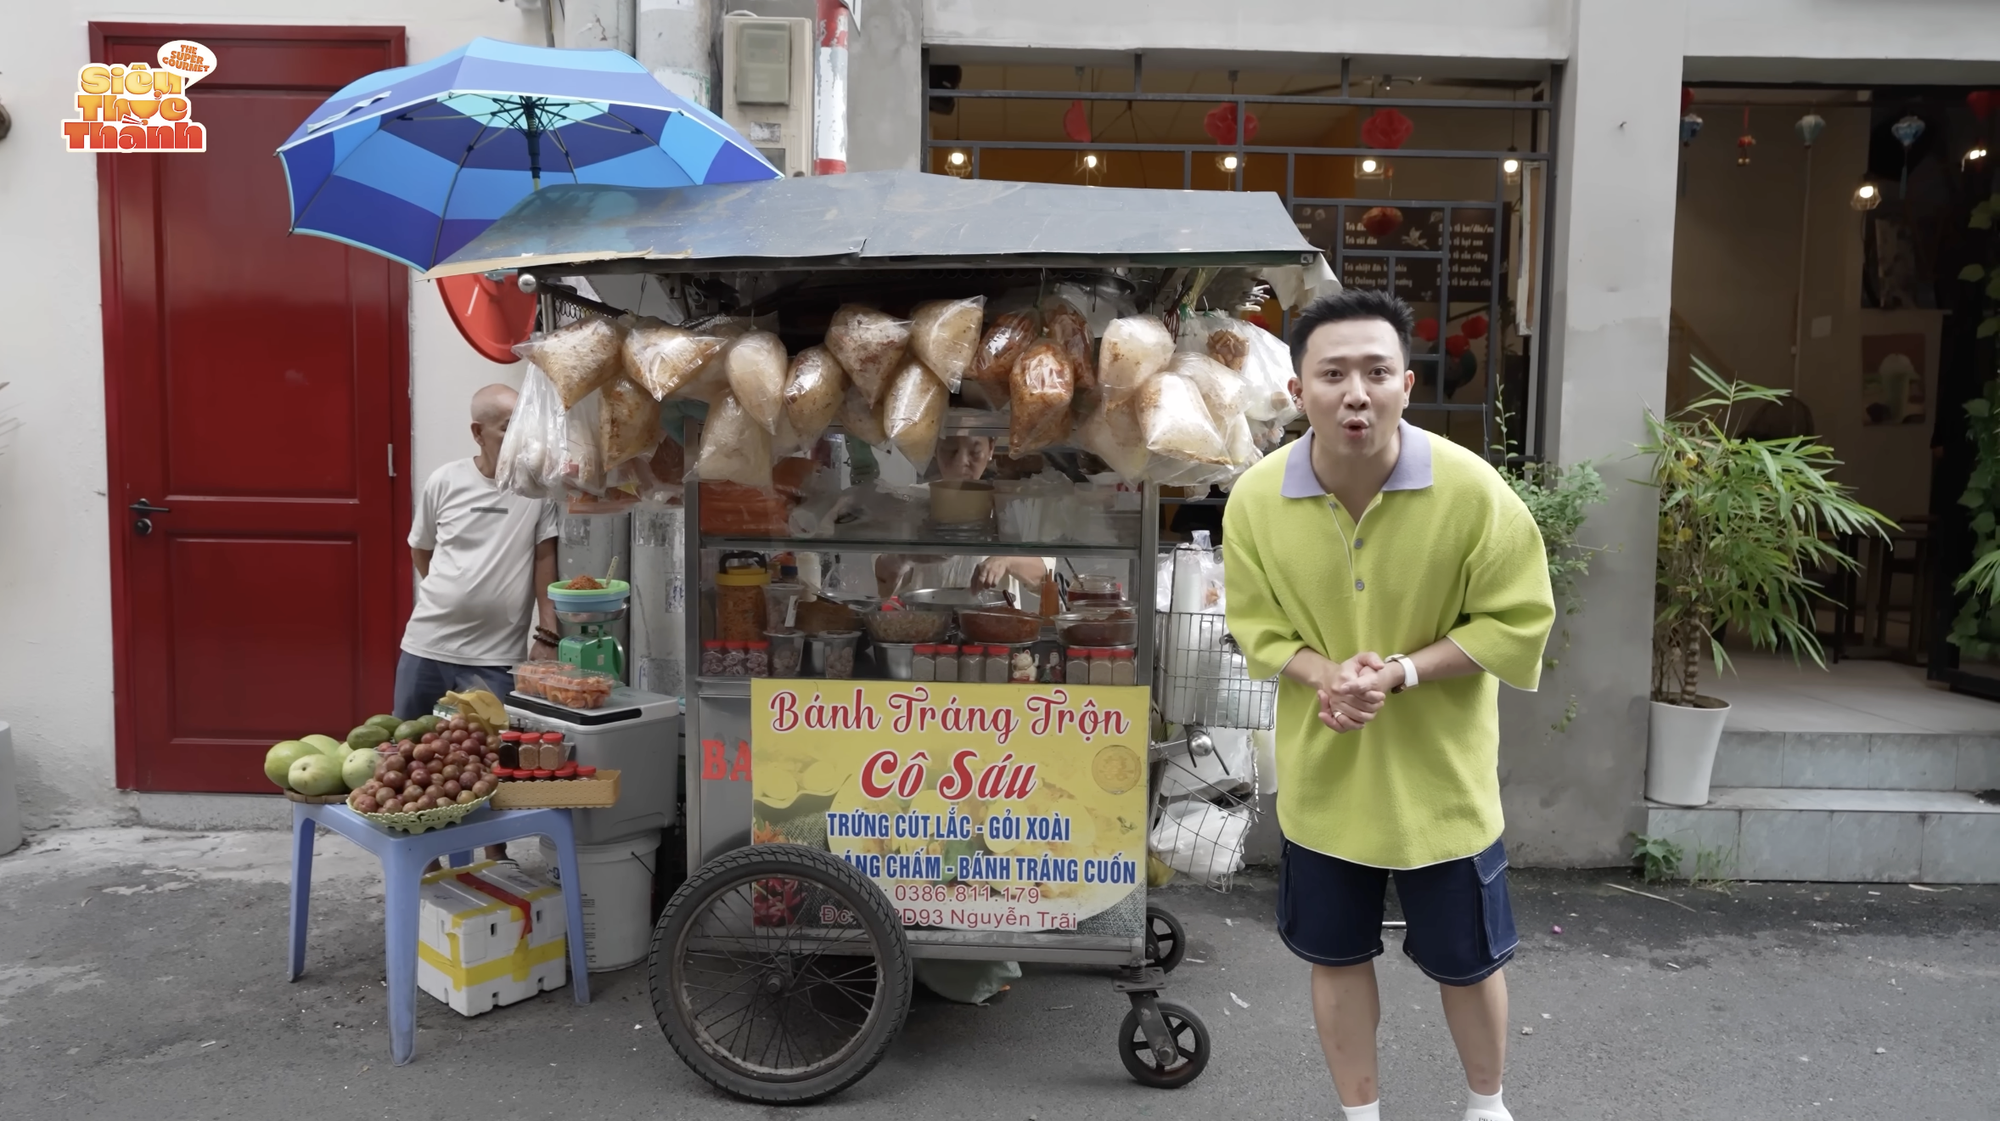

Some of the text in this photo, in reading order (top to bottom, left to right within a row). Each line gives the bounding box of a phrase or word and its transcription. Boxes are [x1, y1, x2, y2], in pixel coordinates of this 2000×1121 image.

[769, 686, 1130, 744] Bánh Tráng Trộn
[860, 750, 1037, 801] Cô Sáu
[827, 809, 890, 838] TRỨNG
[895, 810, 931, 839] CÚT
[935, 806, 972, 840] LẮC
[989, 808, 1021, 840] GỎI
[1025, 812, 1071, 841] XOÀI
[886, 847, 941, 879] CHẤM
[959, 852, 1011, 880] BÁNH
[1015, 853, 1079, 883] TRÁNG
[1083, 852, 1136, 884] CUỐN
[895, 885, 1040, 904] 0386.811.179
[950, 906, 1030, 929] Nguyễn
[1036, 911, 1077, 929] Trãi
